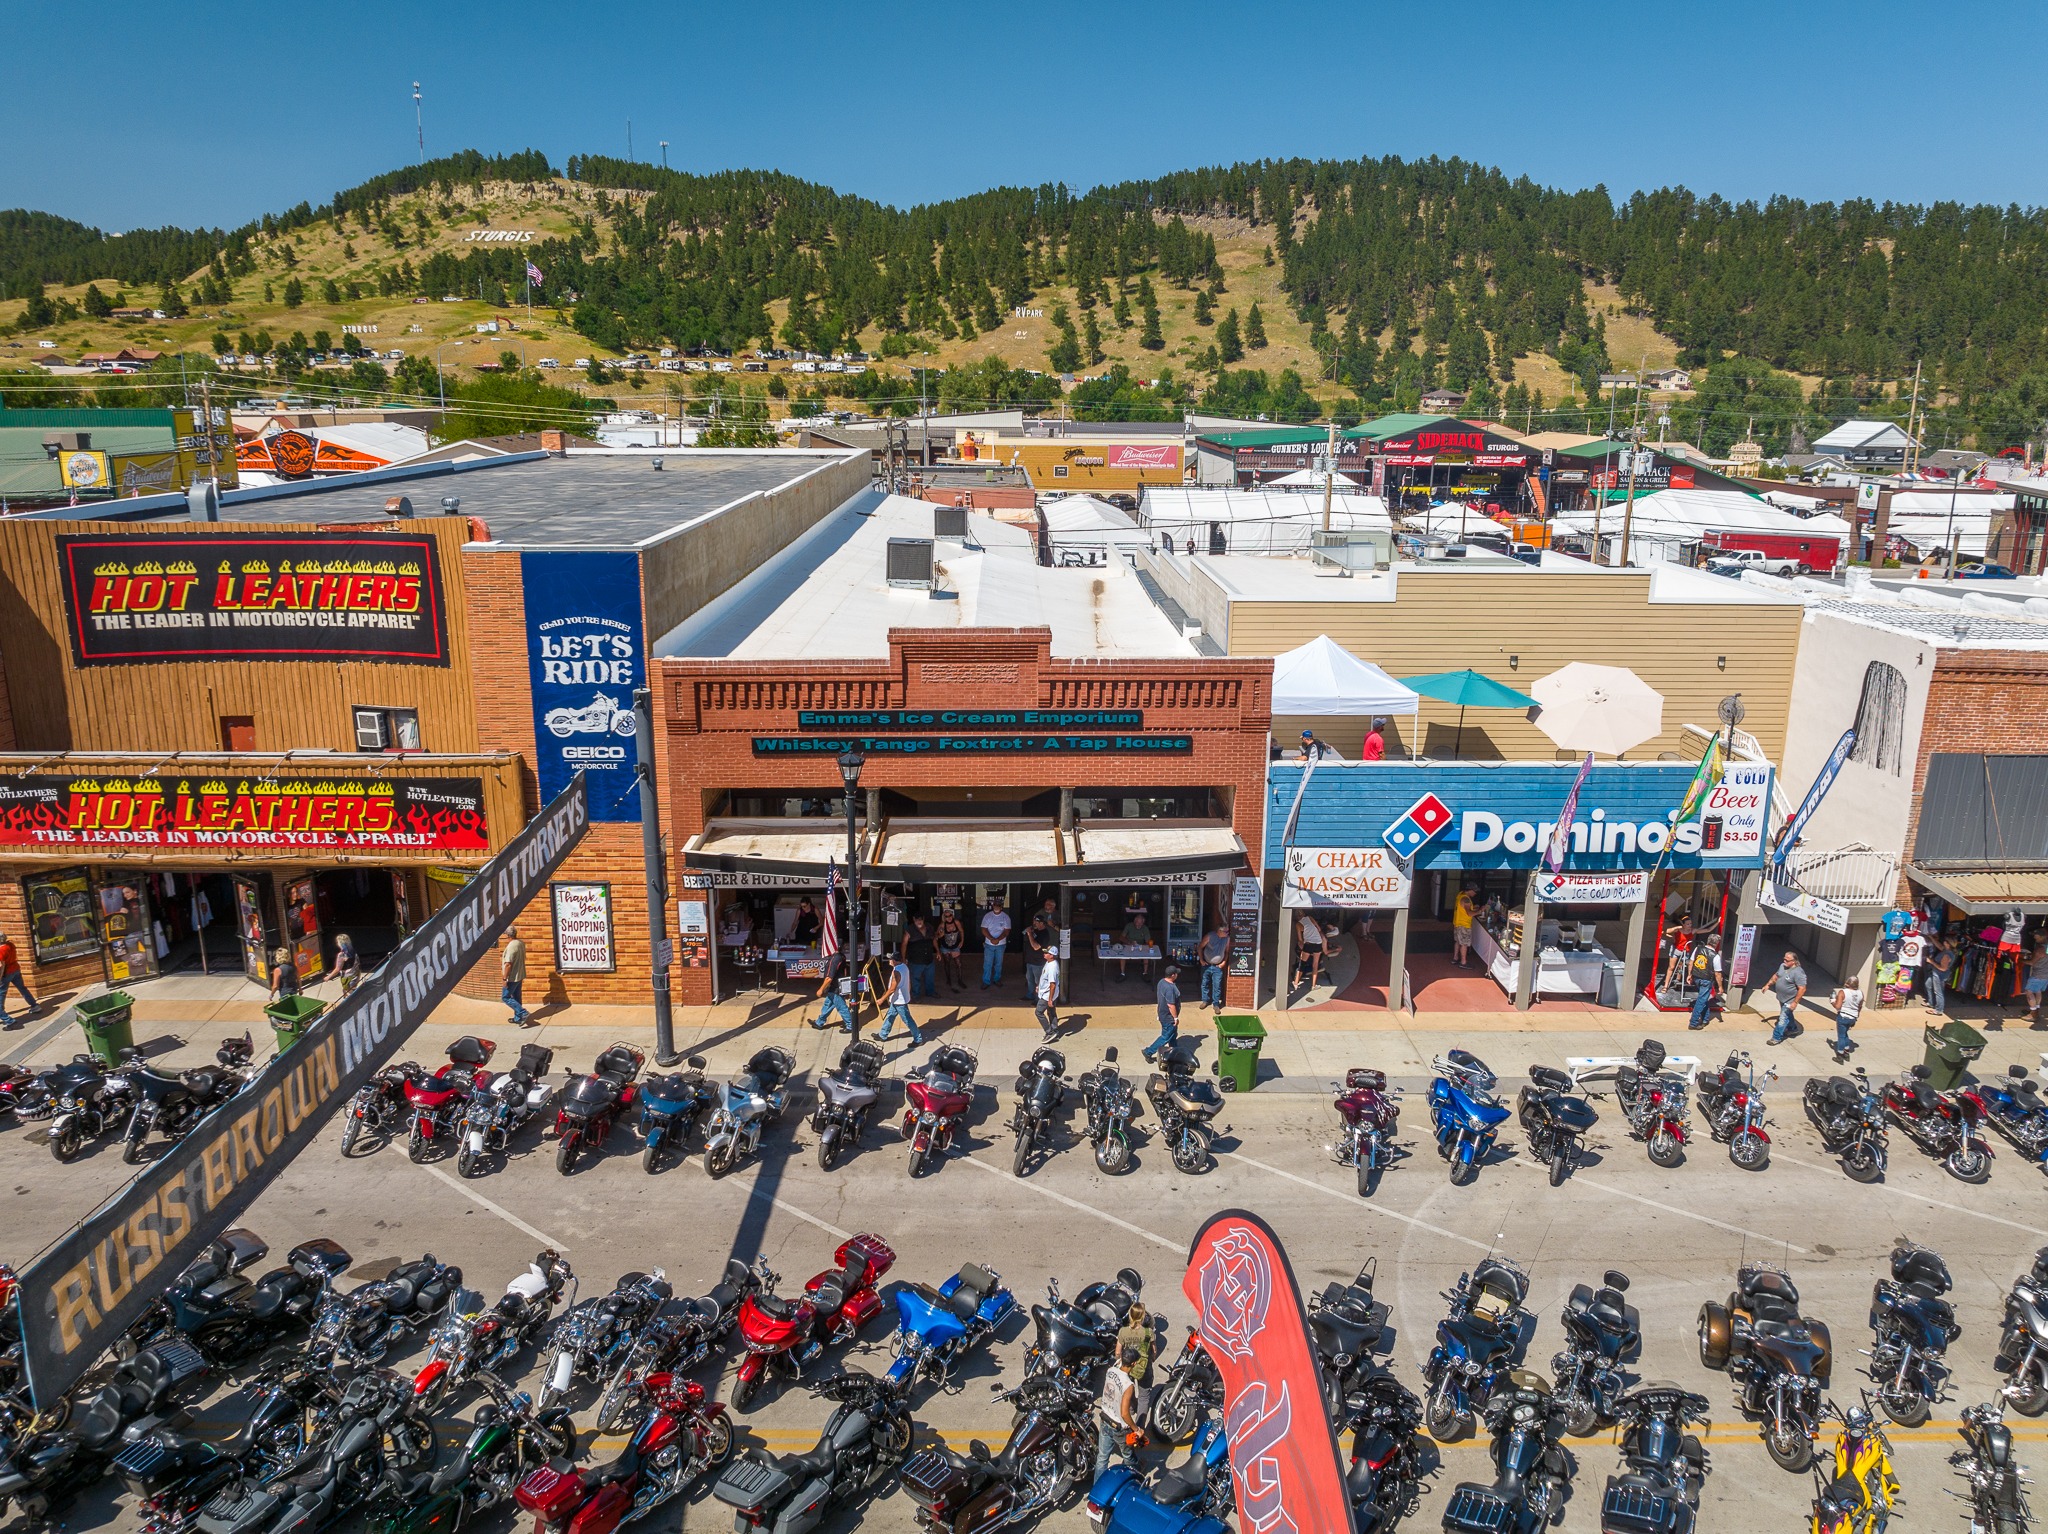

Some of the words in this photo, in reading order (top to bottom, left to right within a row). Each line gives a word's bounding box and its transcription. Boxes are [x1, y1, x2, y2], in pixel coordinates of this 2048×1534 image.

[464, 230, 535, 242] STURGIS
[1015, 306, 1026, 318] RV
[1026, 309, 1043, 318] PARK
[342, 325, 378, 334] STURGIS
[1271, 443, 1308, 454] GUNNER'S
[1311, 442, 1341, 454] LOUNE
[1417, 433, 1485, 451] SIDEHACK
[1487, 444, 1519, 452] STURGIS
[1121, 448, 1163, 459] Budweiser
[341, 461, 352, 469] THE
[353, 461, 377, 469] LEGEND
[1075, 456, 1104, 466] LIQUOR
[1618, 467, 1671, 477] SIHACK
[89, 575, 199, 613] HOT
[213, 574, 422, 613] LEATHERS
[91, 614, 132, 630] THE
[134, 613, 205, 629] LEADER
[208, 612, 230, 627] IN
[232, 612, 345, 628] MOTORCYCLE
[539, 618, 564, 631] GLAD
[564, 616, 600, 625] YOU'RE
[600, 617, 631, 632] HERE!
[539, 633, 633, 659] LET'S
[543, 660, 633, 685] RIDE
[801, 712, 890, 724] Emma's
[898, 712, 933, 724] Ice
[941, 712, 1016, 724] Cream
[1024, 711, 1138, 726] Emporium
[755, 738, 853, 753] Whiskey
[860, 738, 930, 752] Tango
[939, 737, 1022, 750] Foxtrot
[1043, 737, 1060, 749] A
[1066, 737, 1107, 751] Tap
[1115, 736, 1188, 749] House
[562, 746, 626, 759] GEICO
[1736, 767, 1766, 784] COLD
[0, 788, 58, 799] OTLEATHERS
[407, 791, 477, 805] HOTLEATHERS
[1709, 787, 1759, 808] Beer
[67, 794, 164, 829] HOT
[174, 794, 394, 831] LEATHERS
[1729, 814, 1755, 828] Only
[32, 830, 76, 842] THE
[82, 830, 160, 843] LEADER
[166, 831, 188, 843] IN
[194, 831, 338, 844] MOTORCYCLE
[1460, 808, 1703, 854] Domino's
[1723, 831, 1758, 842] $3.50
[1317, 852, 1383, 868] CHAIR
[683, 875, 712, 888] BEER
[713, 874, 738, 885] EER
[741, 874, 749, 885] &
[752, 874, 778, 885] HOT
[782, 876, 810, 885] DOG
[1297, 877, 1399, 892] MASSAGE
[1569, 875, 1593, 885] PIZZA
[1617, 874, 1642, 885] SLICE
[558, 891, 598, 902] Thank
[1571, 888, 1588, 900] ICE
[1589, 887, 1611, 900] COLD
[1613, 887, 1641, 900] DRINKS
[579, 901, 603, 917] You
[1825, 903, 1840, 912] Pizza
[561, 918, 605, 932] SHOPPING
[1817, 913, 1828, 921] Beer
[1829, 918, 1841, 926] Patio
[1817, 920, 1838, 931] Upstairs
[562, 933, 606, 946] DOWNTOWN
[562, 947, 606, 962] STURGIS
[51, 1176, 193, 1355] RUSS
[200, 1032, 342, 1213] BROWN
[339, 877, 496, 1071] MOTORCYCLE
[494, 788, 586, 919] ATTORNEYS
